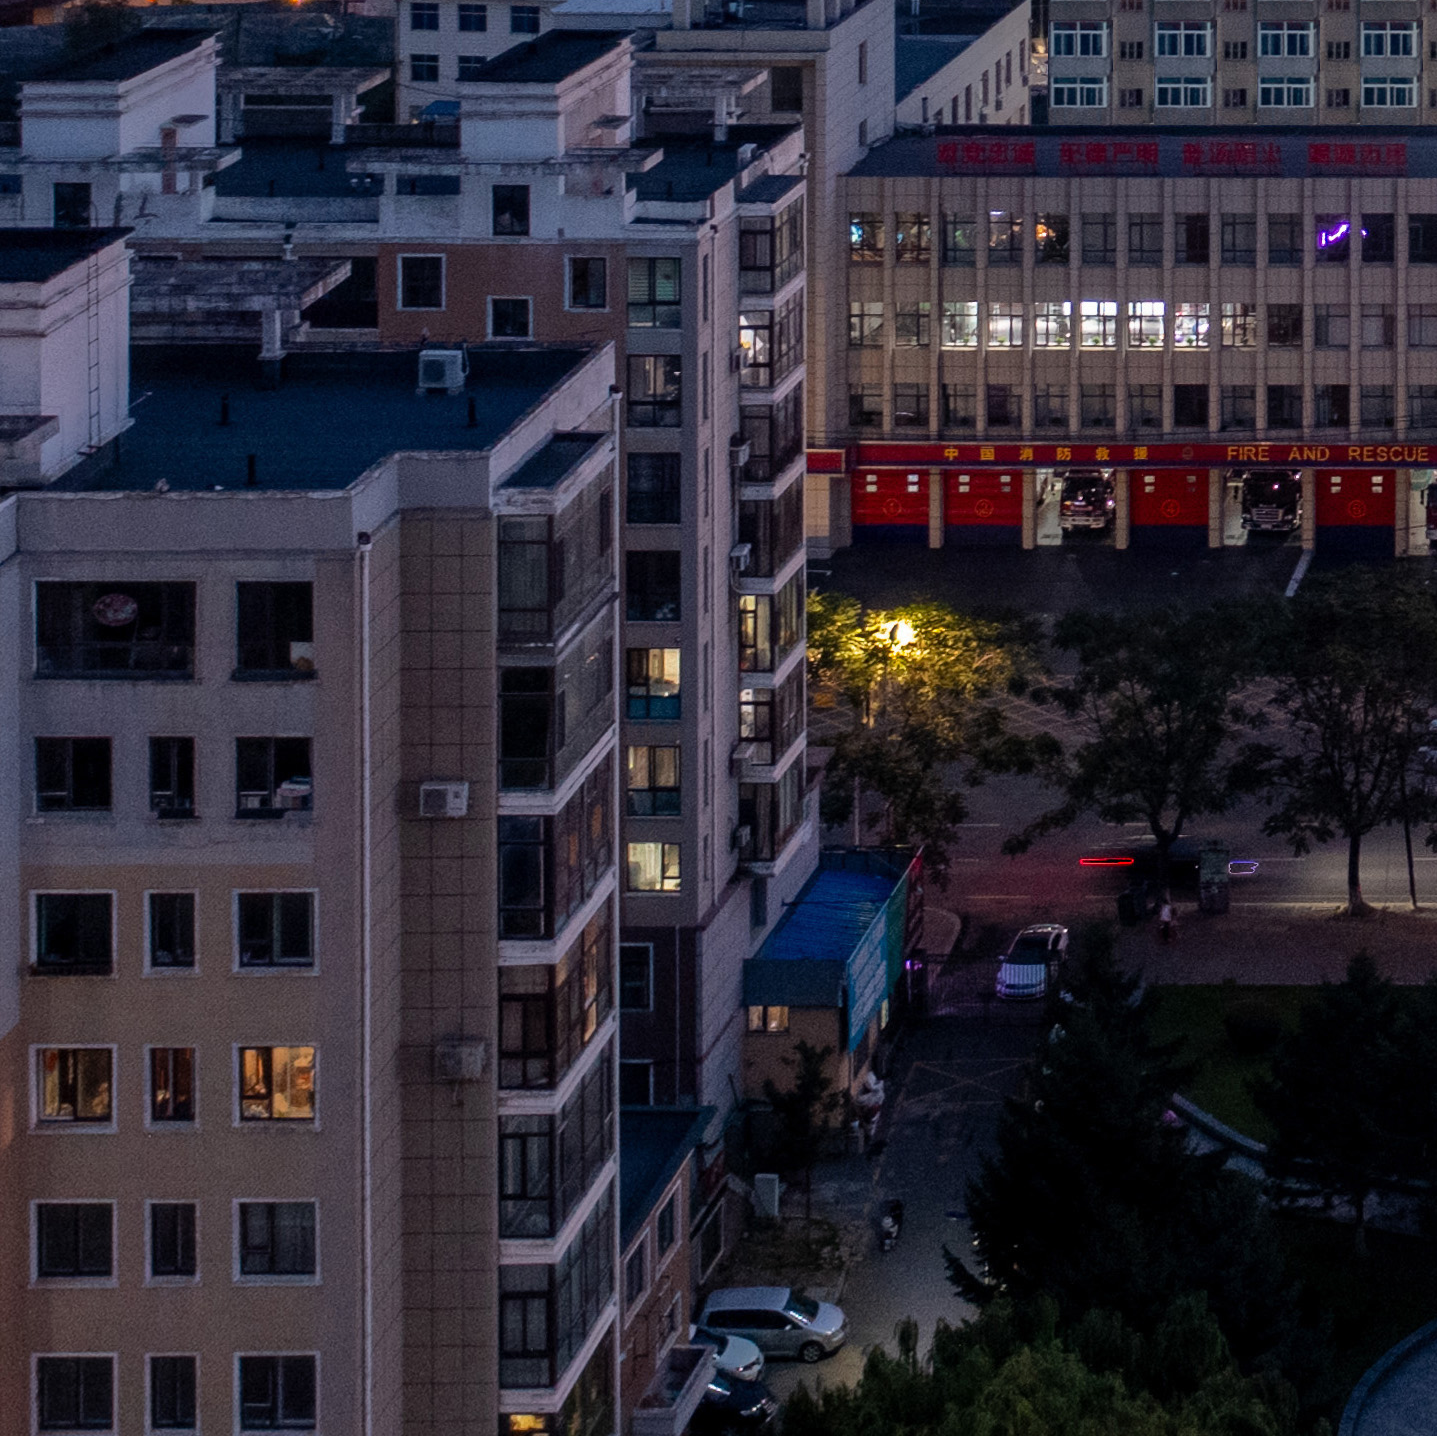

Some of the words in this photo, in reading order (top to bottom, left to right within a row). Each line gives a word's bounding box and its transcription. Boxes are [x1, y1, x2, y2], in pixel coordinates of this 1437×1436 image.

[943, 445, 1149, 463] 中国消防救援
[1226, 445, 1271, 462] FIRE
[1287, 445, 1330, 462] AND
[1347, 445, 1430, 462] RESCUE
